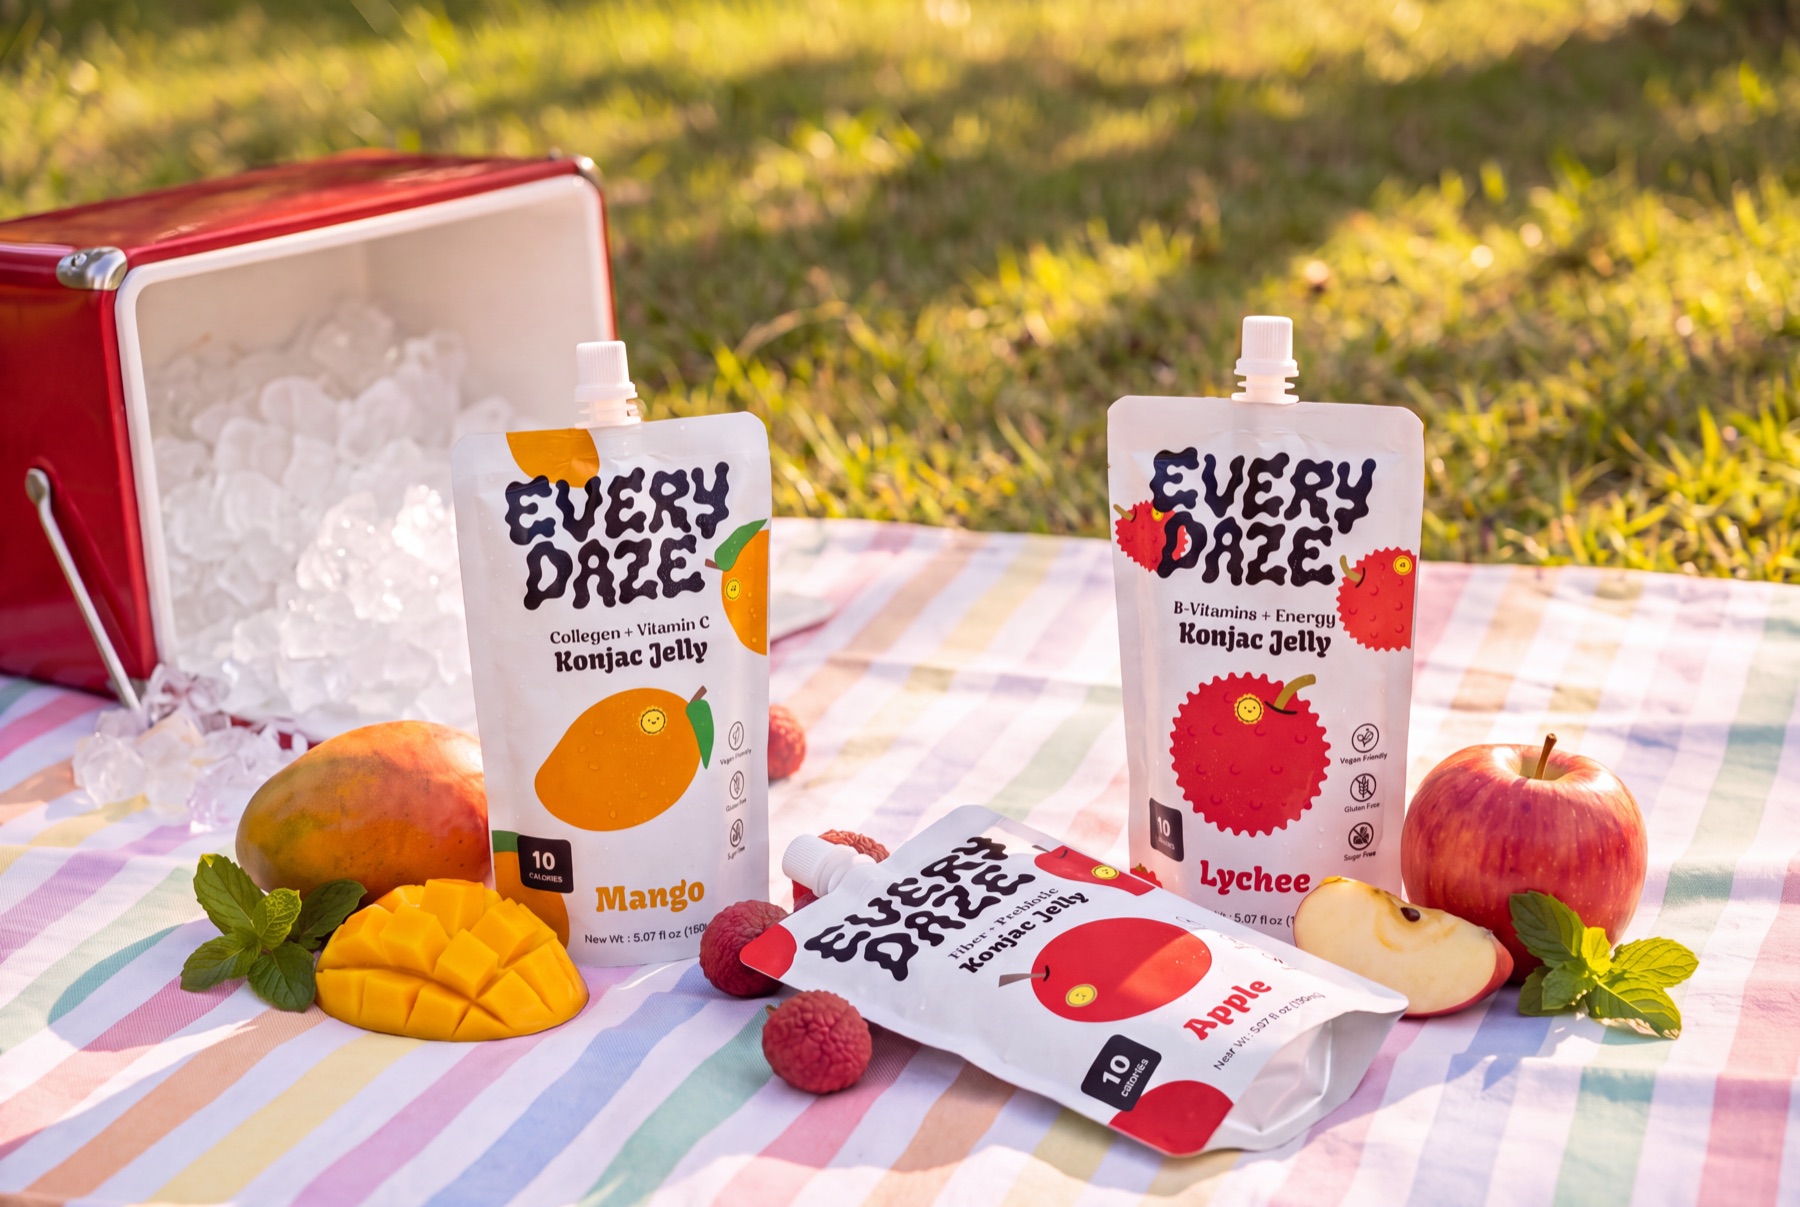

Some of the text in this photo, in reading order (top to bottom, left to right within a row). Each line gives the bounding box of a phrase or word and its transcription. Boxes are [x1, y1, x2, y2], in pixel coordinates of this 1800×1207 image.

[504, 461, 730, 546] EVERY
[1149, 446, 1376, 534] EVERY
[1156, 510, 1336, 587] DAZE
[523, 534, 706, 611] DAZE
[549, 627, 621, 646] Collegen
[636, 617, 696, 637] Vitamin
[699, 615, 710, 629] C
[1173, 600, 1257, 621] B-Vitamins
[1275, 608, 1336, 629] Energy
[554, 637, 708, 674] Konjac Jelly
[1178, 621, 1332, 658] Konjac Jelly
[1340, 752, 1388, 765] Vegan Friendly
[1157, 816, 1171, 837] 10
[1344, 804, 1366, 813] Gluten
[529, 872, 563, 883] CALORIES
[532, 850, 556, 870] 10
[1200, 859, 1311, 896] Lychee
[595, 878, 705, 913] Mango
[804, 836, 1008, 963] EVERY
[609, 934, 625, 944] Wt
[633, 931, 656, 943] 5.07
[659, 930, 667, 940] fl
[668, 930, 682, 940] oz
[864, 864, 1036, 982] DAZE
[948, 931, 989, 960] Fiber
[993, 887, 1059, 926] Prebiotic
[958, 891, 1090, 974] Konjac Jelly
[1234, 912, 1257, 924] 5.07
[1260, 914, 1268, 925] fl
[1269, 916, 1283, 926] oz
[1183, 979, 1272, 1041] Apple
[1213, 1047, 1236, 1071] Near
[1233, 1035, 1250, 1048] Wt
[1279, 1005, 1292, 1015] oz
[1102, 1054, 1131, 1085] 10
